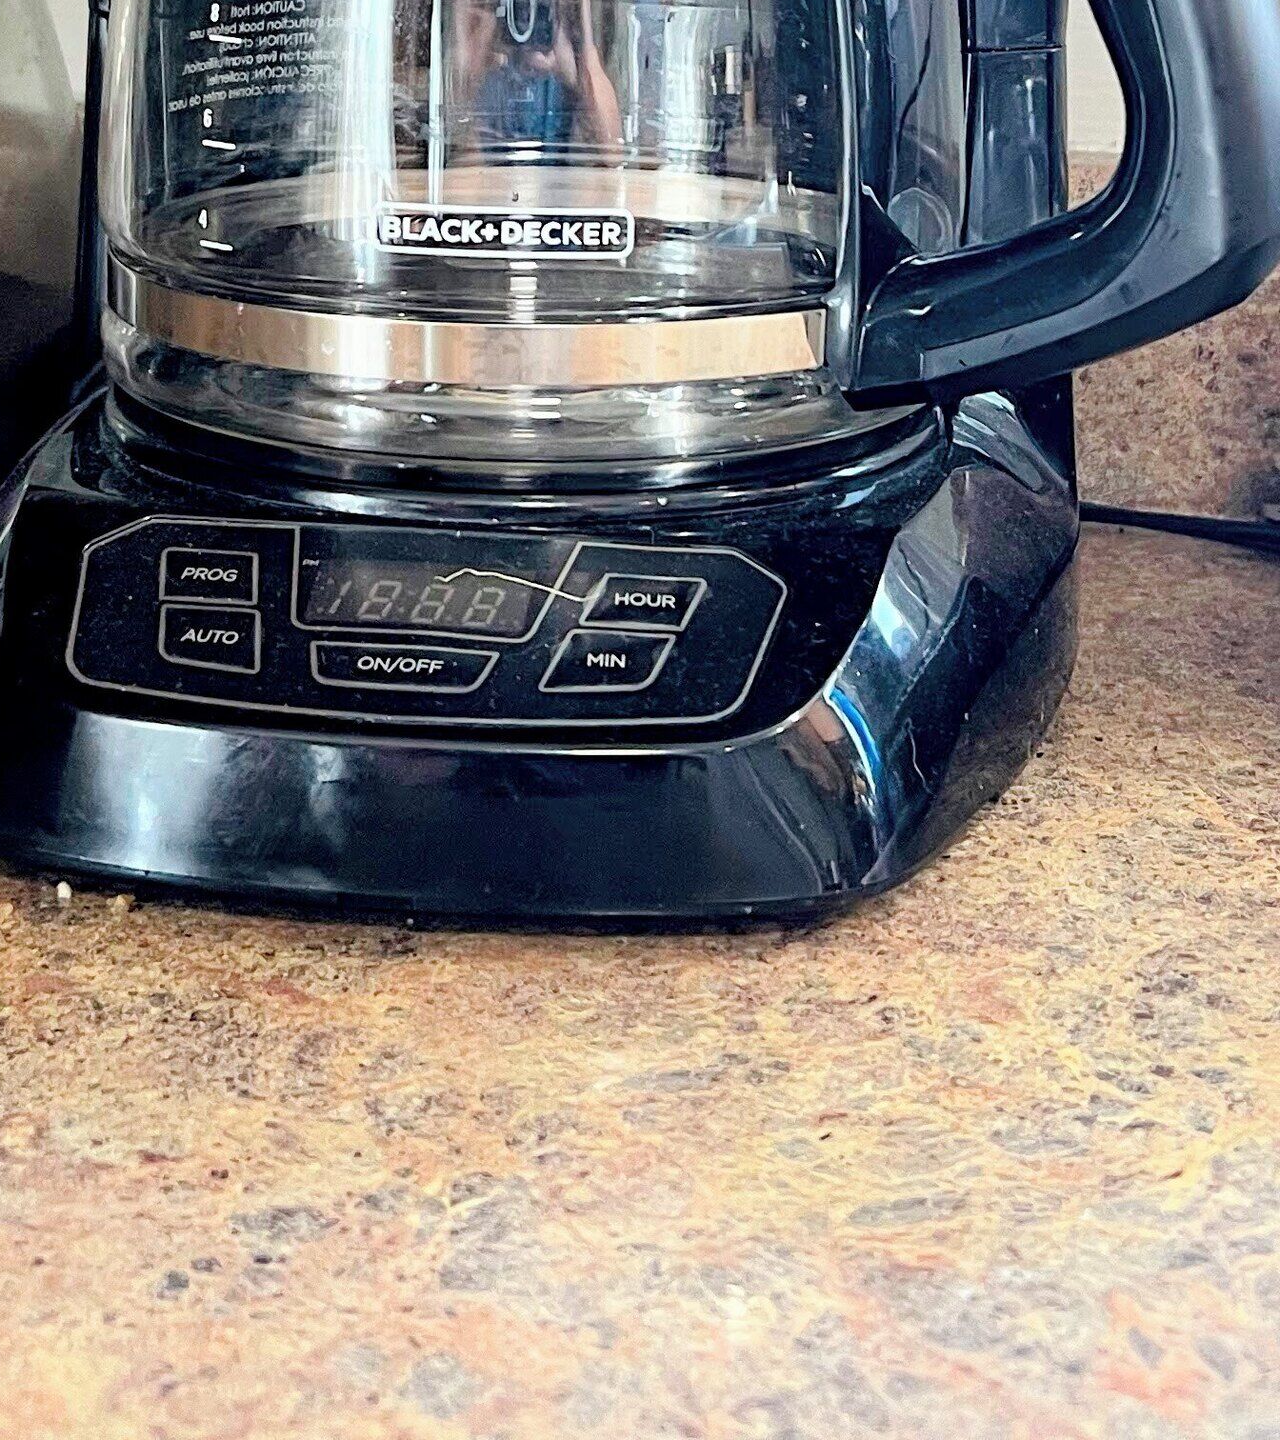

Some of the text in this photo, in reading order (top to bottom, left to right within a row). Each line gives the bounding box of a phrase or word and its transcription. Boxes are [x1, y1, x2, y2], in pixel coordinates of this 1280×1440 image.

[209, 2, 220, 23] 8
[202, 108, 213, 129] 6
[197, 209, 208, 229] 4
[382, 215, 621, 246] BLACK+DECKER
[180, 566, 239, 583] PROG
[614, 592, 677, 609] HOUR
[180, 628, 239, 645] AUTO
[356, 655, 445, 674] ON/OFF
[586, 652, 627, 669] MIN
